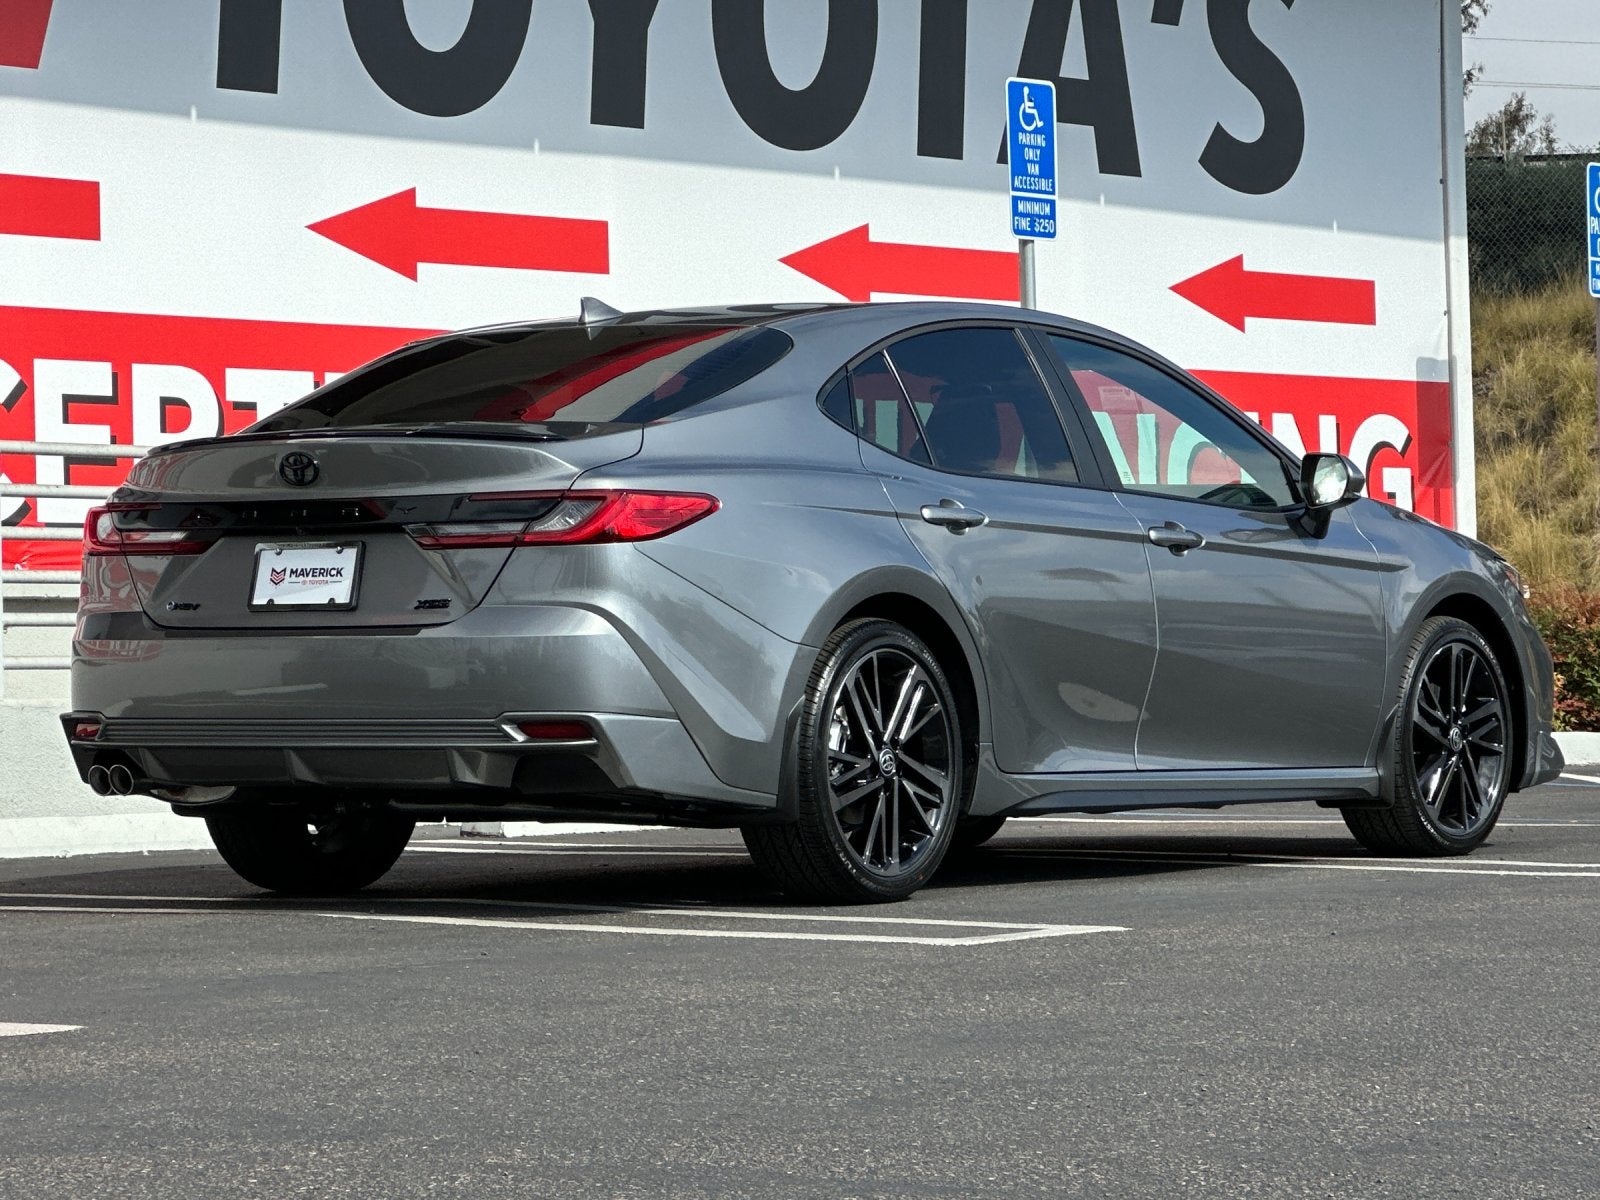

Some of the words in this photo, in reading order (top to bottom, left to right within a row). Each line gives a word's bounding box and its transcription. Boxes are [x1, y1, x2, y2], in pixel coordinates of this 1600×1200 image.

[1018, 132, 1046, 147] PARKING
[1024, 147, 1040, 161] ONLY
[1027, 162, 1039, 176] VAN
[1014, 175, 1053, 192] ACCESSIBLE
[1018, 200, 1050, 216] MINIMUM
[1014, 216, 1031, 231] FINE
[1034, 217, 1055, 234] $250
[289, 567, 344, 578] MAVERICK
